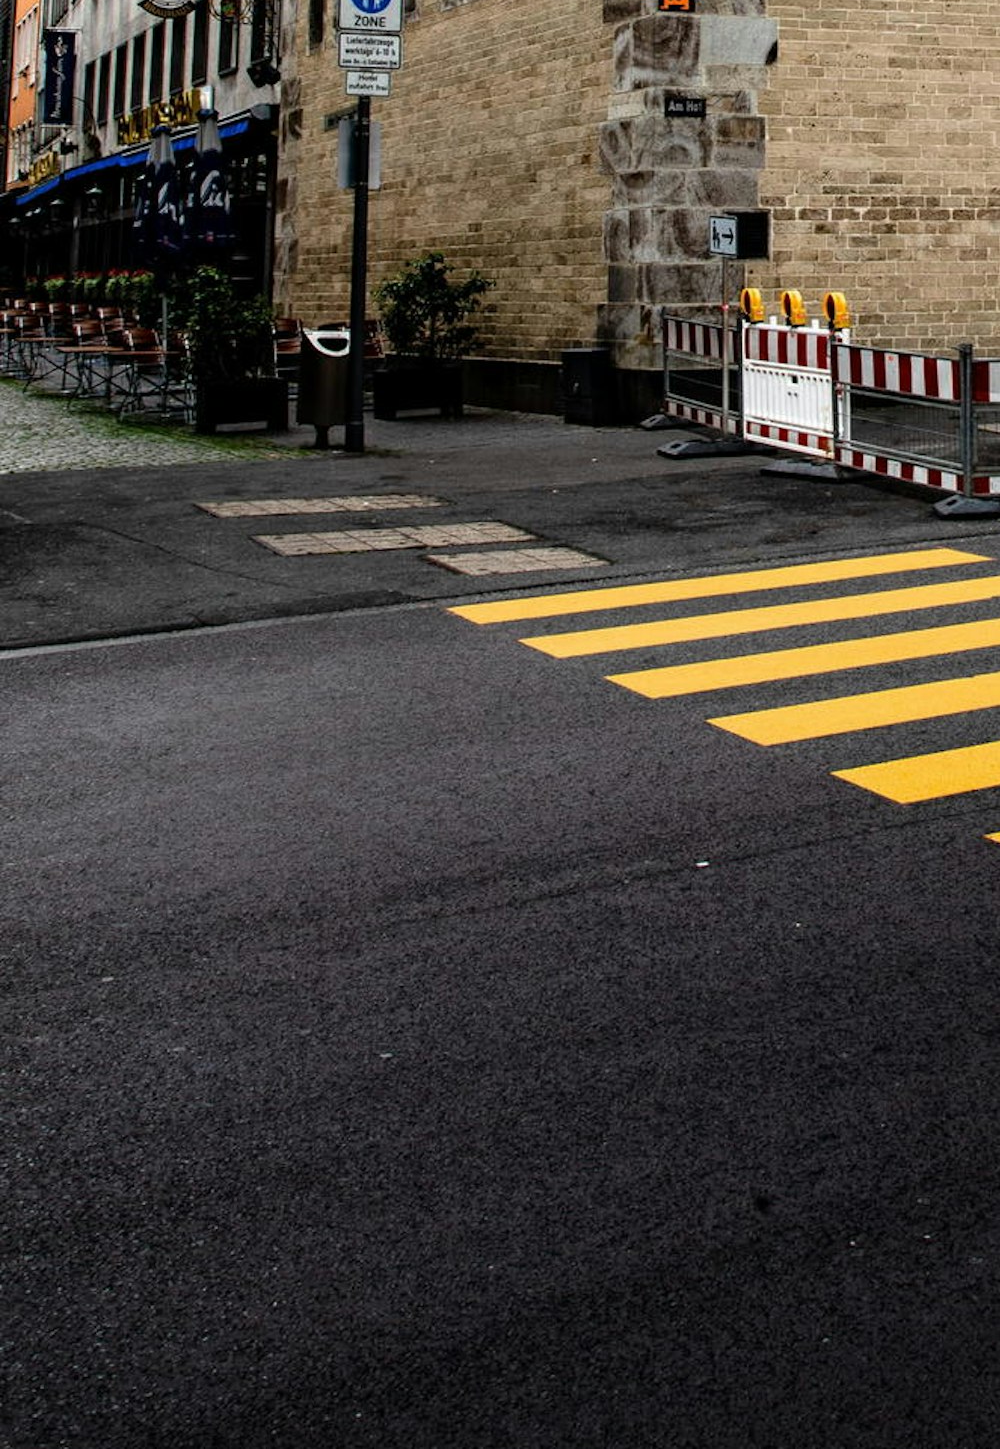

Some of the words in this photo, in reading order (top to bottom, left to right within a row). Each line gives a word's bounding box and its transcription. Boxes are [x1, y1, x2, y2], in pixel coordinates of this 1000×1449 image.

[354, 15, 386, 27] ZONE
[667, 100, 685, 112] Am
[686, 100, 703, 113] Hof
